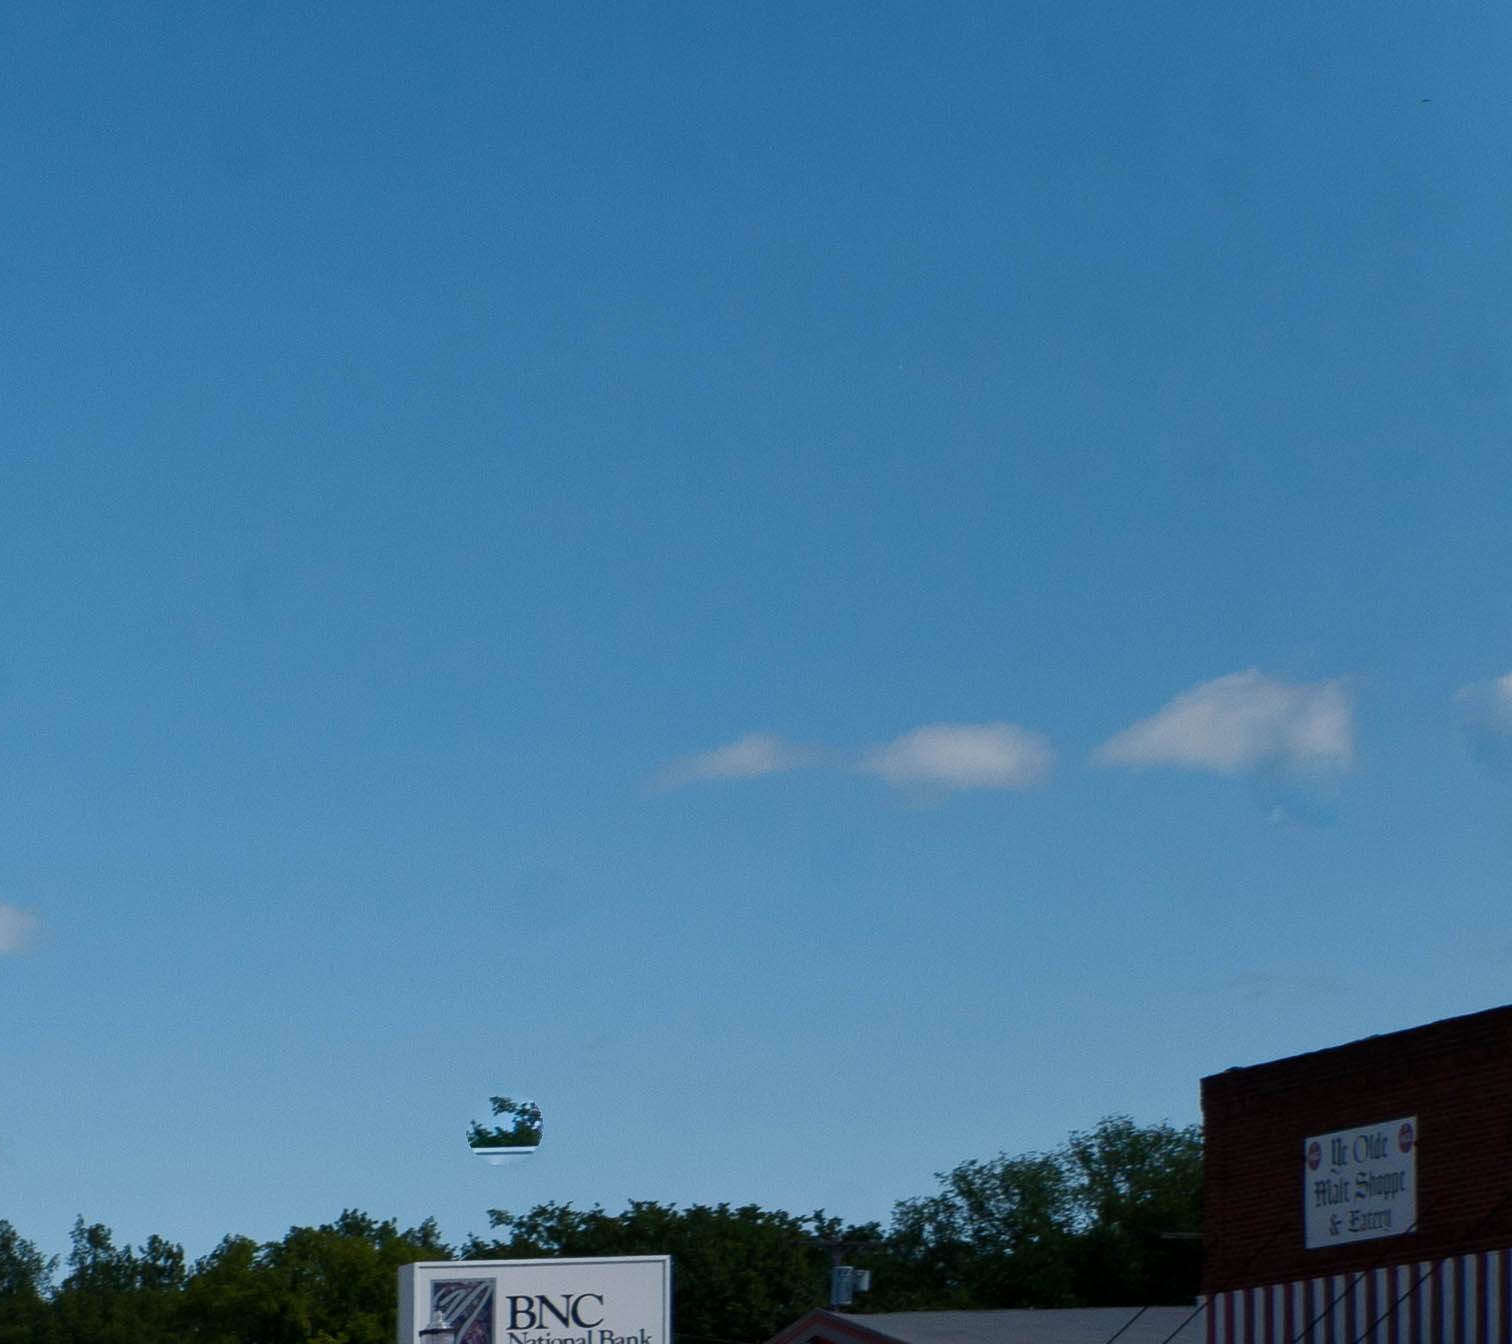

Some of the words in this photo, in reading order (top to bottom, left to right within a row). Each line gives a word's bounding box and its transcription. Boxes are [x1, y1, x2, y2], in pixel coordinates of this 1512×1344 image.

[1331, 1137, 1348, 1174] Ye
[1353, 1133, 1388, 1163] Olde
[1314, 1179, 1350, 1207] Malt
[1354, 1170, 1406, 1200] Shoppe
[1348, 1208, 1393, 1232] Eatery
[506, 1293, 604, 1330] BNC
